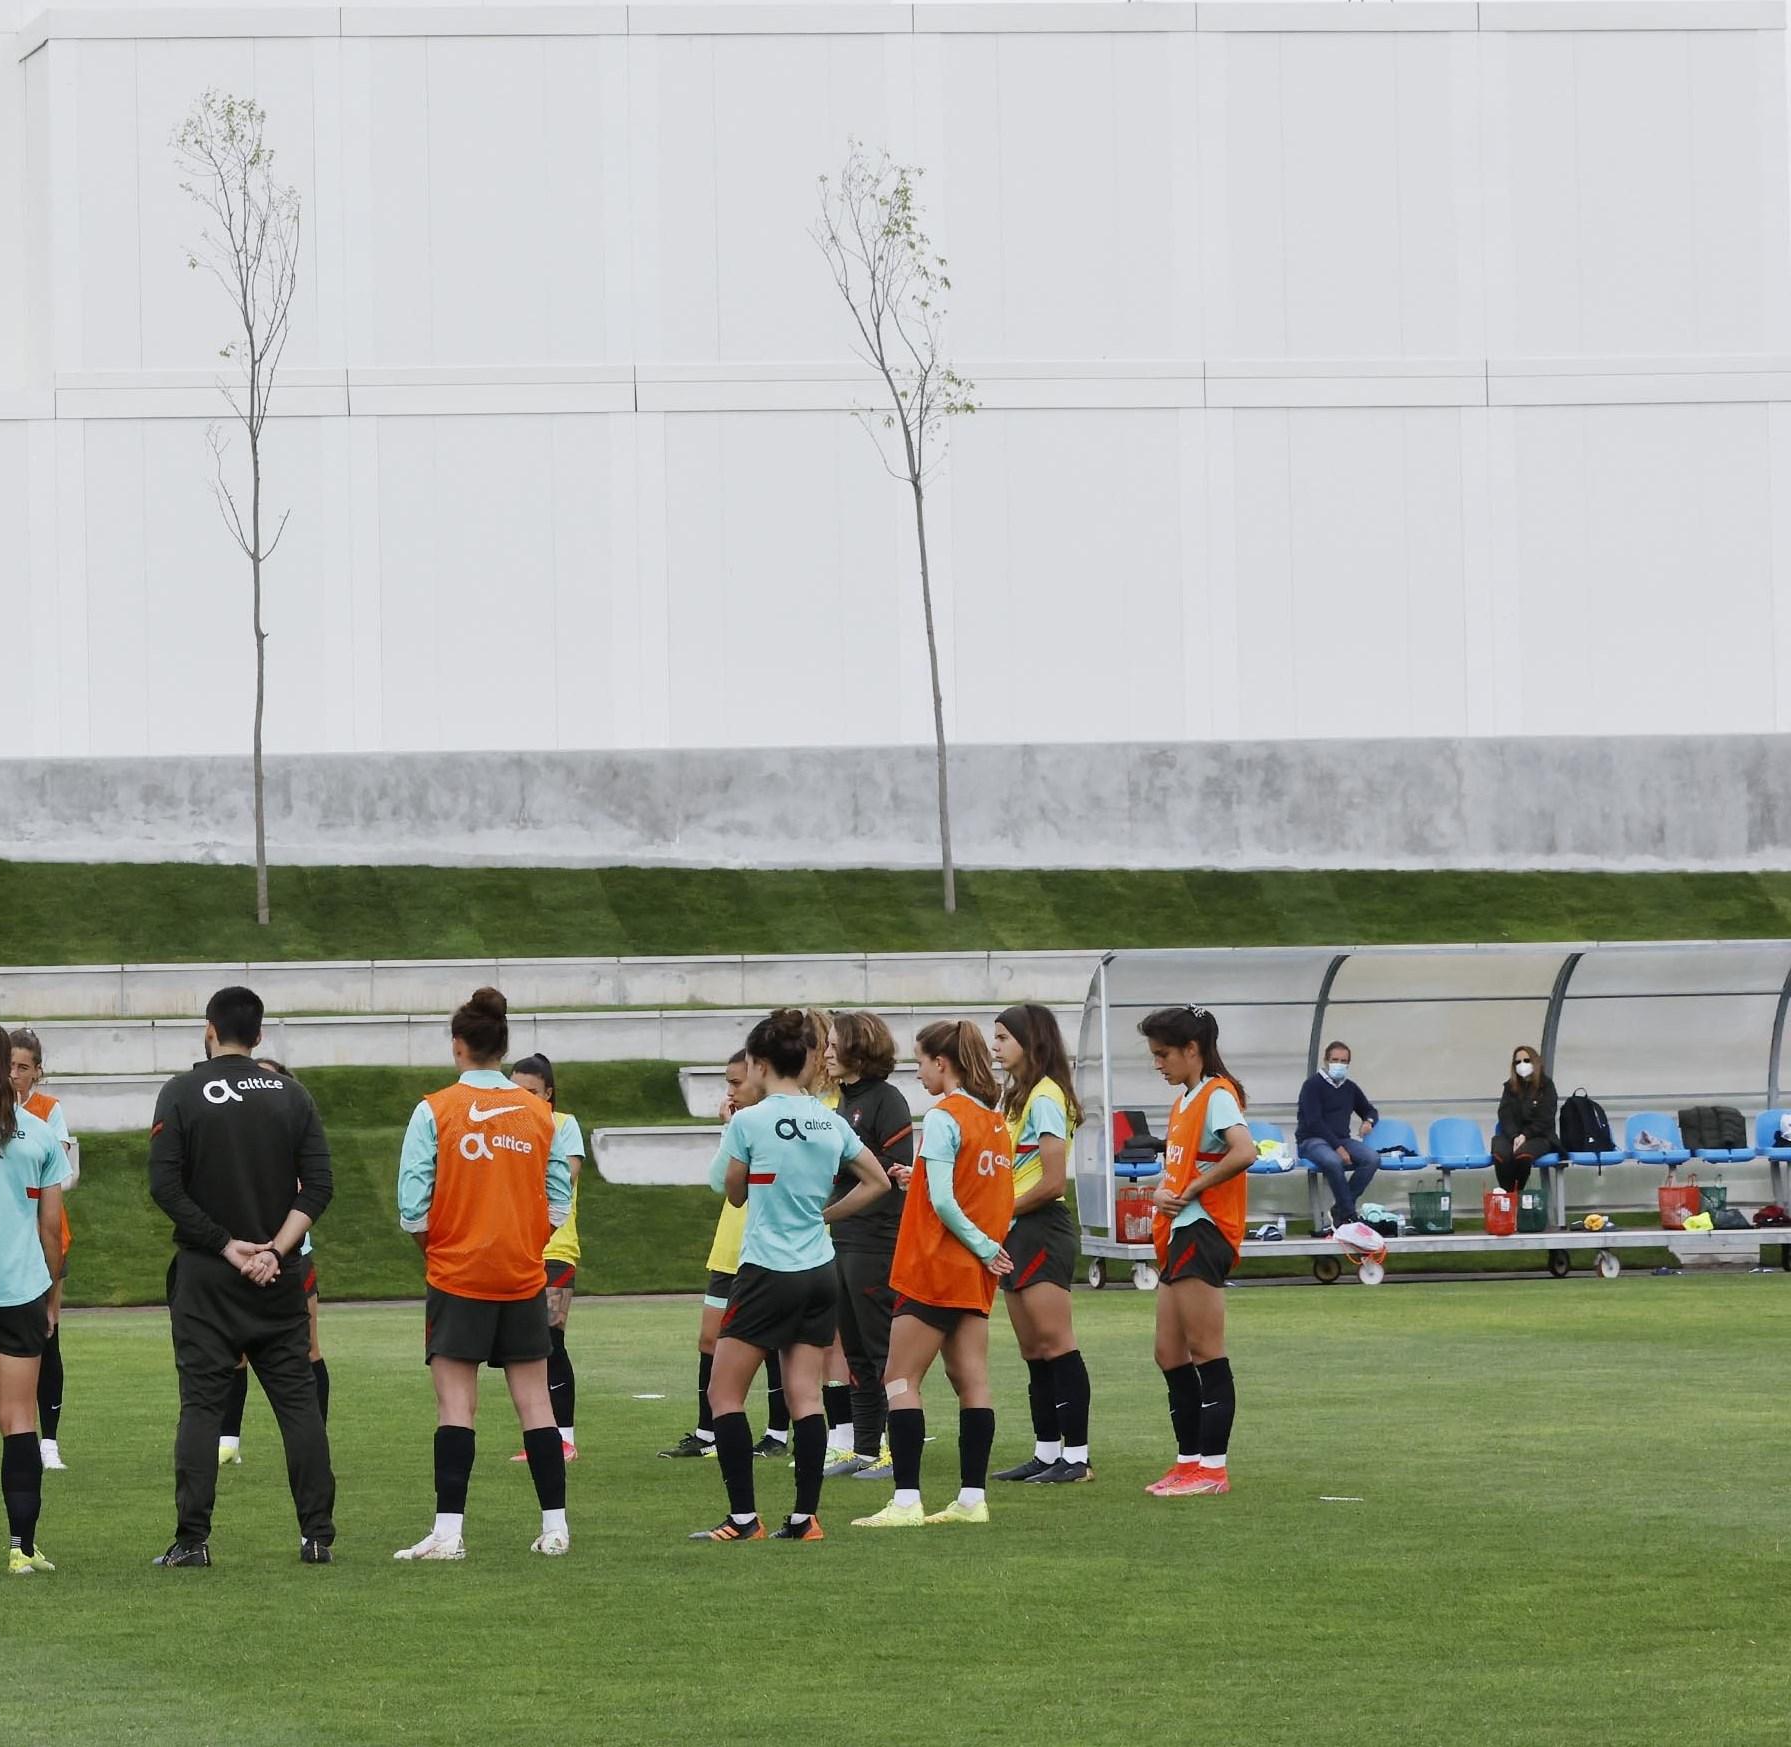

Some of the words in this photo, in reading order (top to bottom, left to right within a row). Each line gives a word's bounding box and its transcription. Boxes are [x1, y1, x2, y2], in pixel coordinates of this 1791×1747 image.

[237, 1078, 284, 1090] altice
[804, 1118, 832, 1130] altice
[491, 1134, 532, 1154] altice
